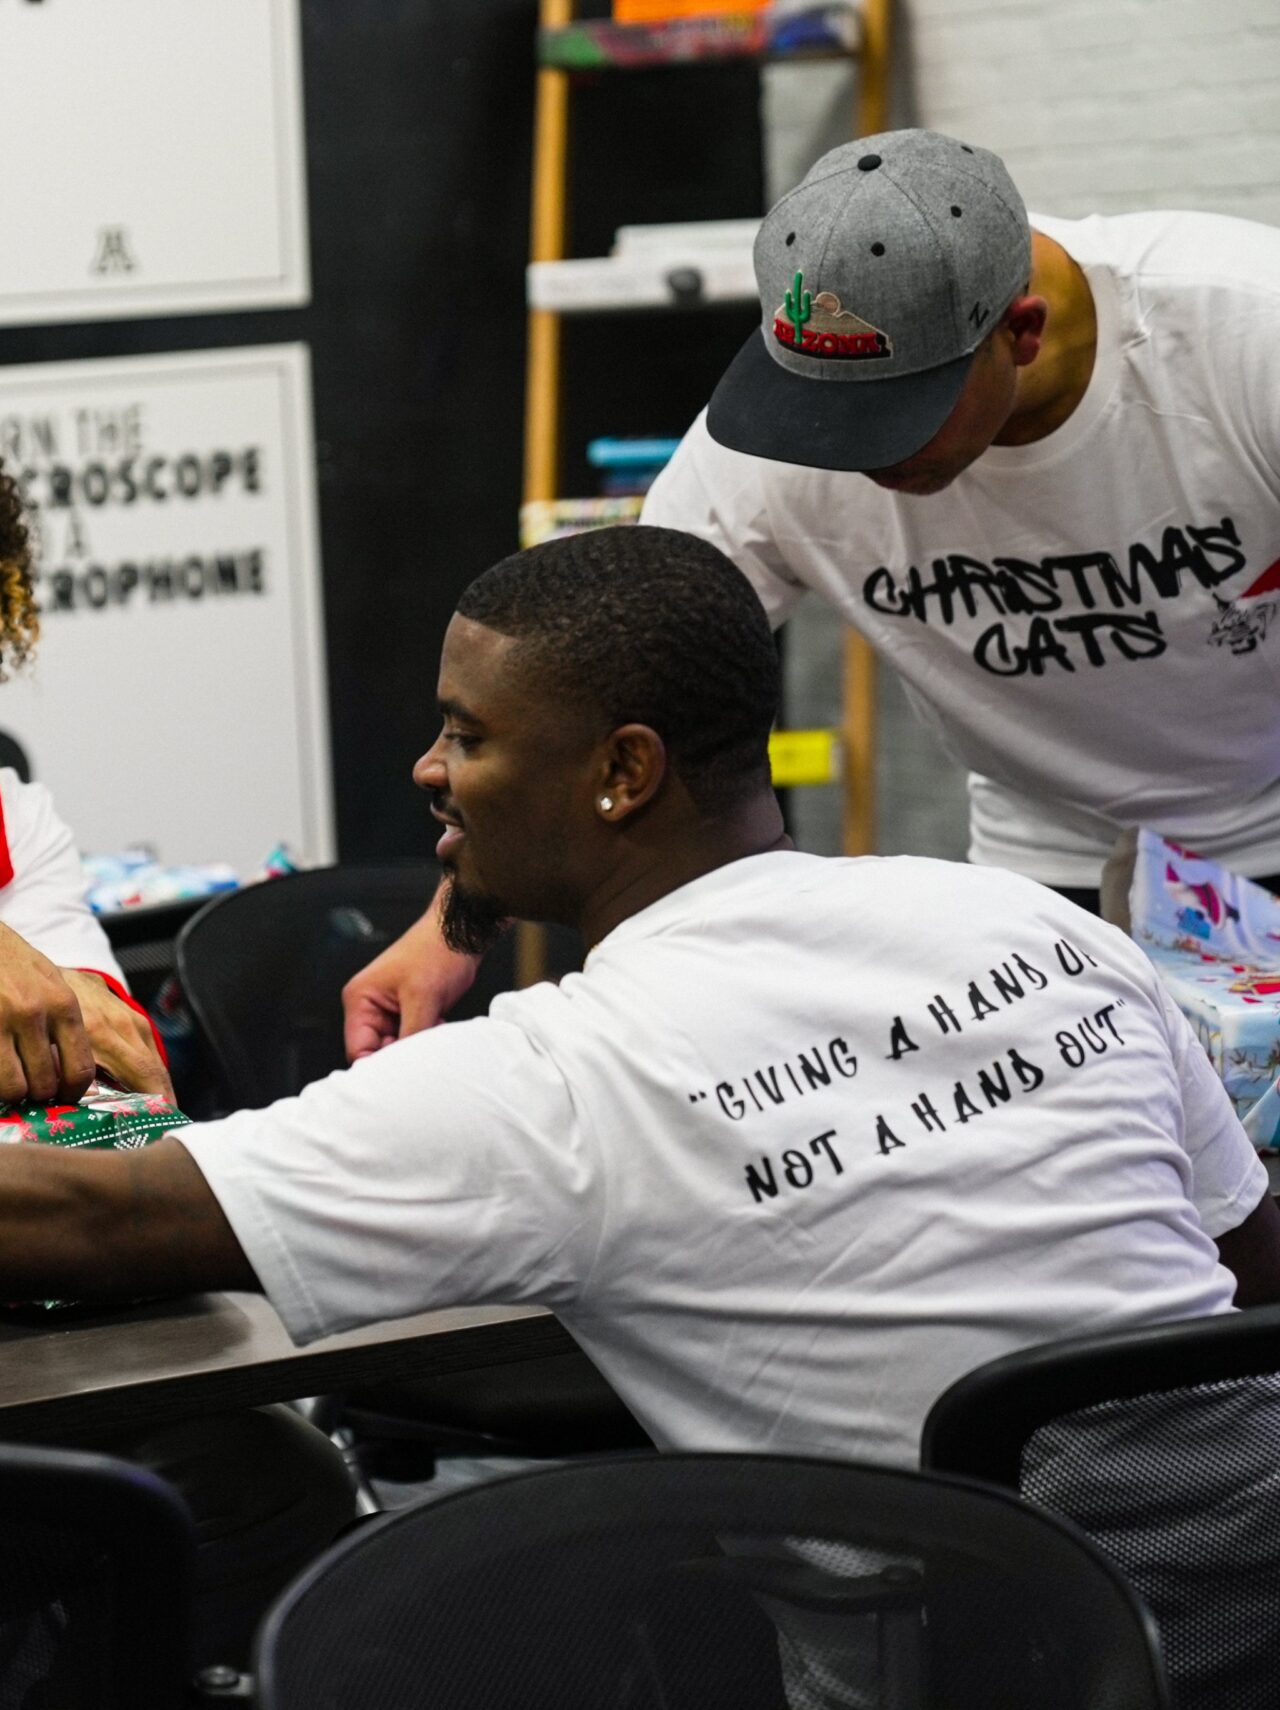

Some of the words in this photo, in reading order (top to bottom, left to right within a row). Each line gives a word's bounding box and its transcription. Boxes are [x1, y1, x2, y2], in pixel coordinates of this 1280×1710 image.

[74, 402, 144, 455] THE
[20, 447, 263, 510] CROSCOPE
[47, 549, 266, 615] ROPHONE
[863, 517, 1247, 625] CHRISTMAS
[973, 610, 1167, 676] CATS
[885, 1016, 919, 1060] A
[927, 953, 1048, 1034] HAND
[744, 1129, 844, 1204] NOT
[874, 1114, 906, 1155] A
[911, 1048, 1044, 1132] HAND
